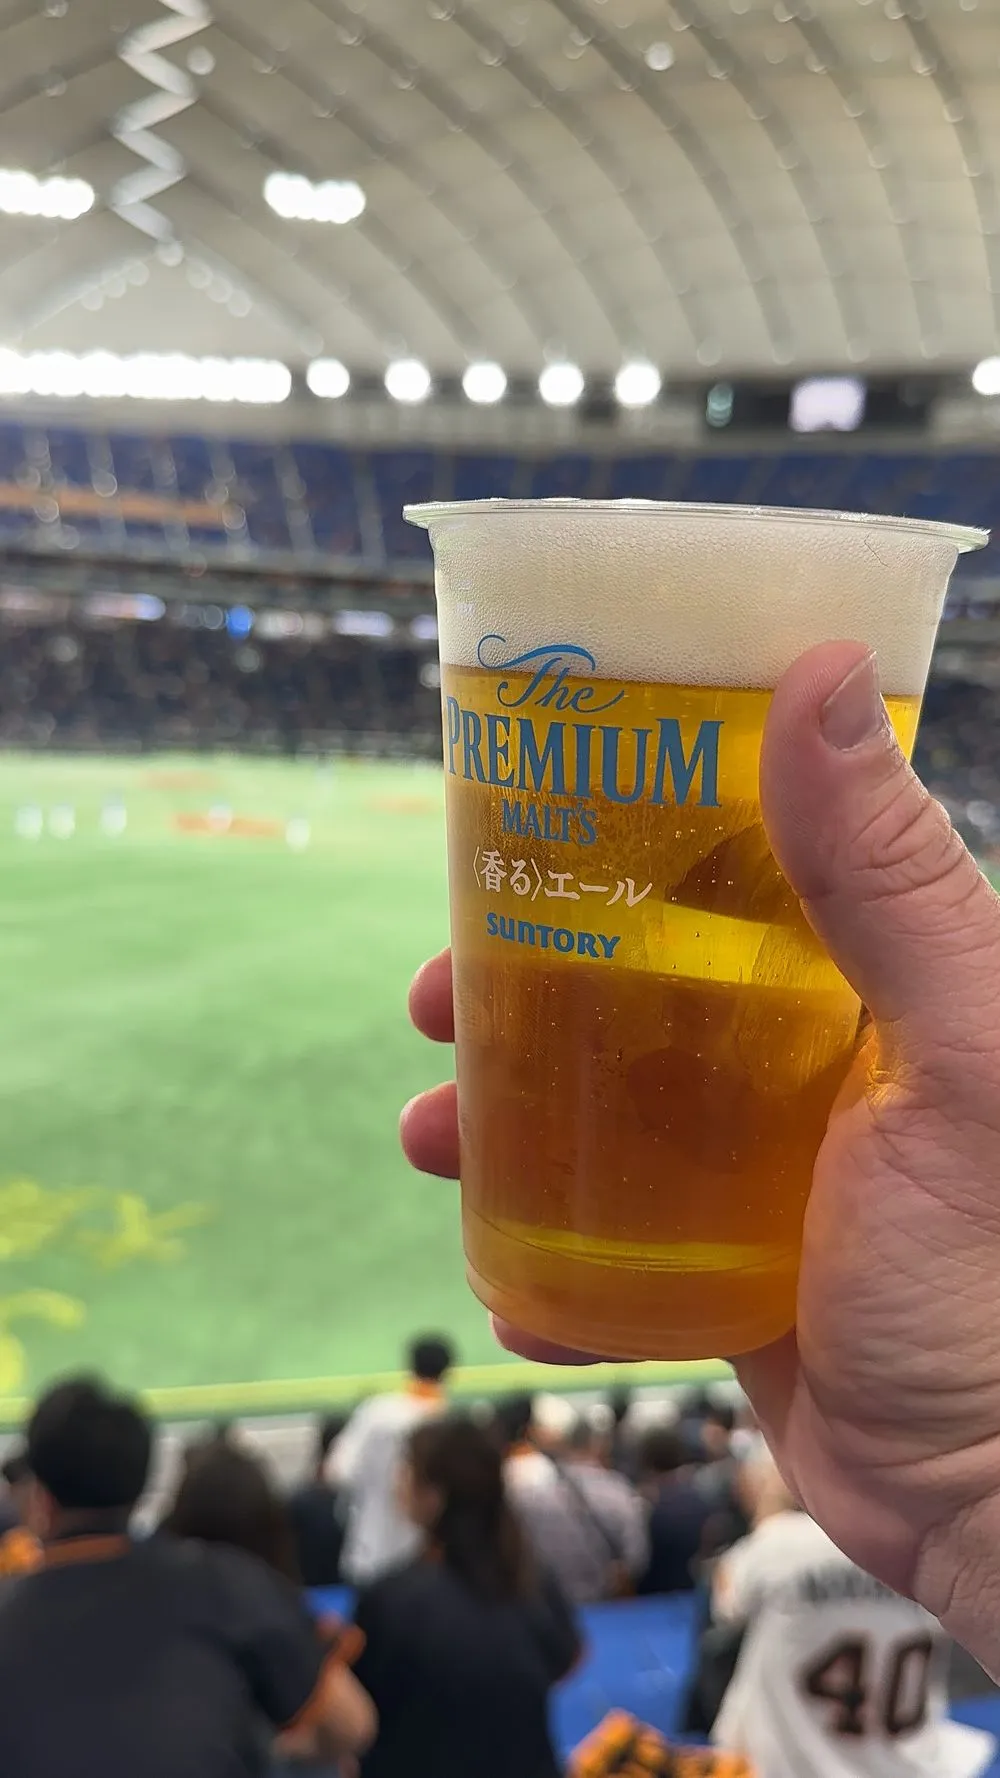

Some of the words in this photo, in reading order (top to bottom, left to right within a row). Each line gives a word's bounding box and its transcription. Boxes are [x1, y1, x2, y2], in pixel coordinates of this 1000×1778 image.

[478, 634, 625, 713] The
[446, 695, 725, 808] PREMIUM
[501, 799, 598, 846] MALT'S
[802, 1632, 934, 1738] 40
